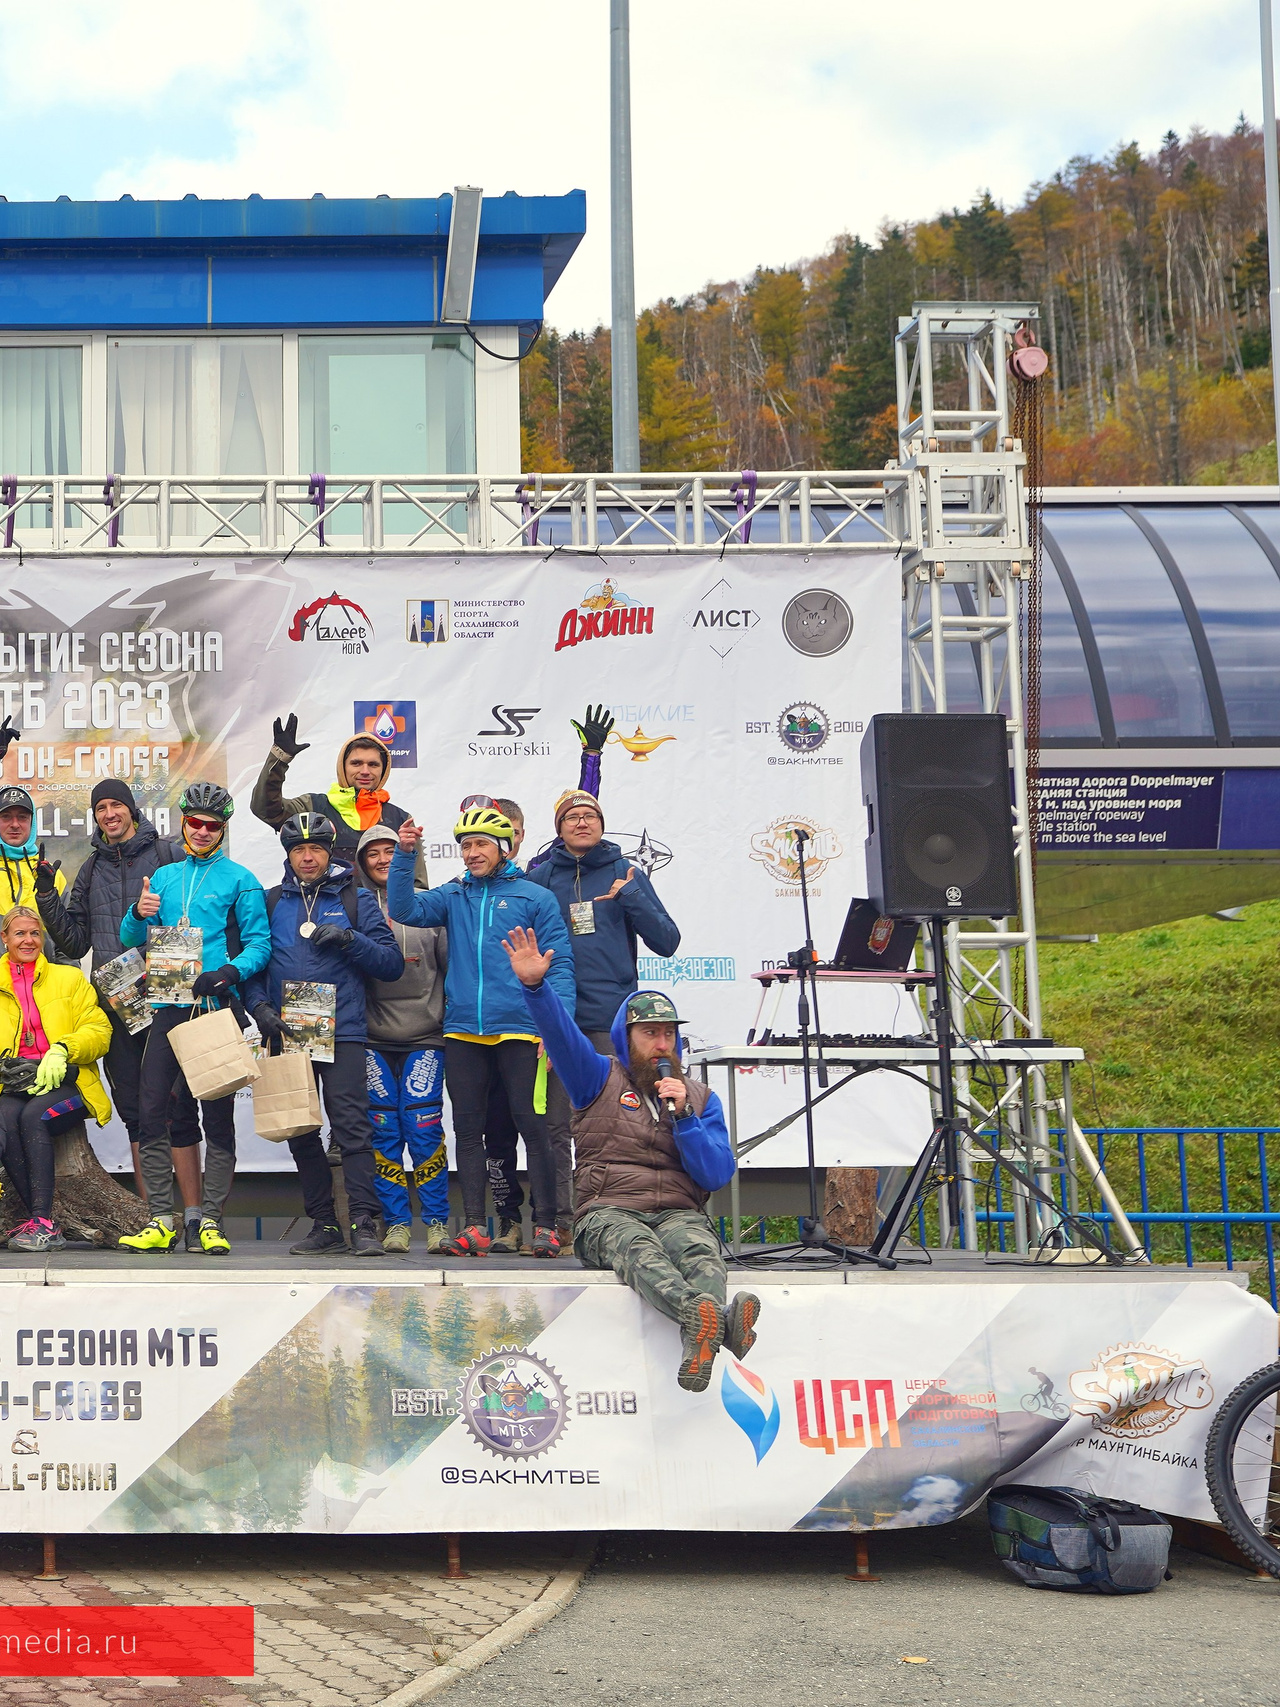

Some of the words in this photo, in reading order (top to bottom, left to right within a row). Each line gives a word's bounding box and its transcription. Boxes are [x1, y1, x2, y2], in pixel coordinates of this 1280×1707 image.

[453, 600, 526, 608] МИНИСТЕРСТВО
[453, 610, 489, 618] СПОРТА
[692, 609, 751, 628] ЛИСТ
[453, 619, 520, 628] САХАЛИНСКОЙ
[453, 631, 495, 639] ОБЛАСТИ
[100, 630, 223, 673] СЕЗОНА
[62, 681, 172, 730] 2023
[745, 721, 775, 734] EST.
[833, 720, 864, 734] 2018
[467, 742, 551, 757] SvaroFskii
[18, 746, 170, 780] DH-CROSS
[767, 756, 844, 766] @SAKHMTBE
[1082, 776, 1128, 789] дорога
[1130, 774, 1215, 789] Doppelmayer
[1075, 788, 1128, 800] станция
[1062, 800, 1087, 811] над
[1089, 799, 1147, 812] уровнем
[1149, 799, 1183, 811] моря
[1094, 810, 1146, 822] ropeway
[1056, 820, 1097, 832] station
[1055, 832, 1091, 843] above
[1093, 832, 1113, 843] the
[1115, 833, 1136, 843] sea
[1138, 831, 1167, 843] level
[685, 957, 735, 980] ЗВЕЗДА
[16, 1329, 139, 1366] СЕЗОНА
[148, 1328, 219, 1367] МТБ
[904, 1379, 947, 1391] ЦЕНТР
[392, 1390, 454, 1416] EST.
[576, 1391, 638, 1416] 2018
[906, 1391, 997, 1405] СПОРТИВНОЙ
[793, 1379, 901, 1455] ЦСП
[908, 1408, 998, 1422] ПОДГОТОВКИ
[10, 1428, 41, 1456] &
[1088, 1438, 1198, 1470] МАУНТИНБАЙКА
[440, 1466, 601, 1485] @SAKHMTBE
